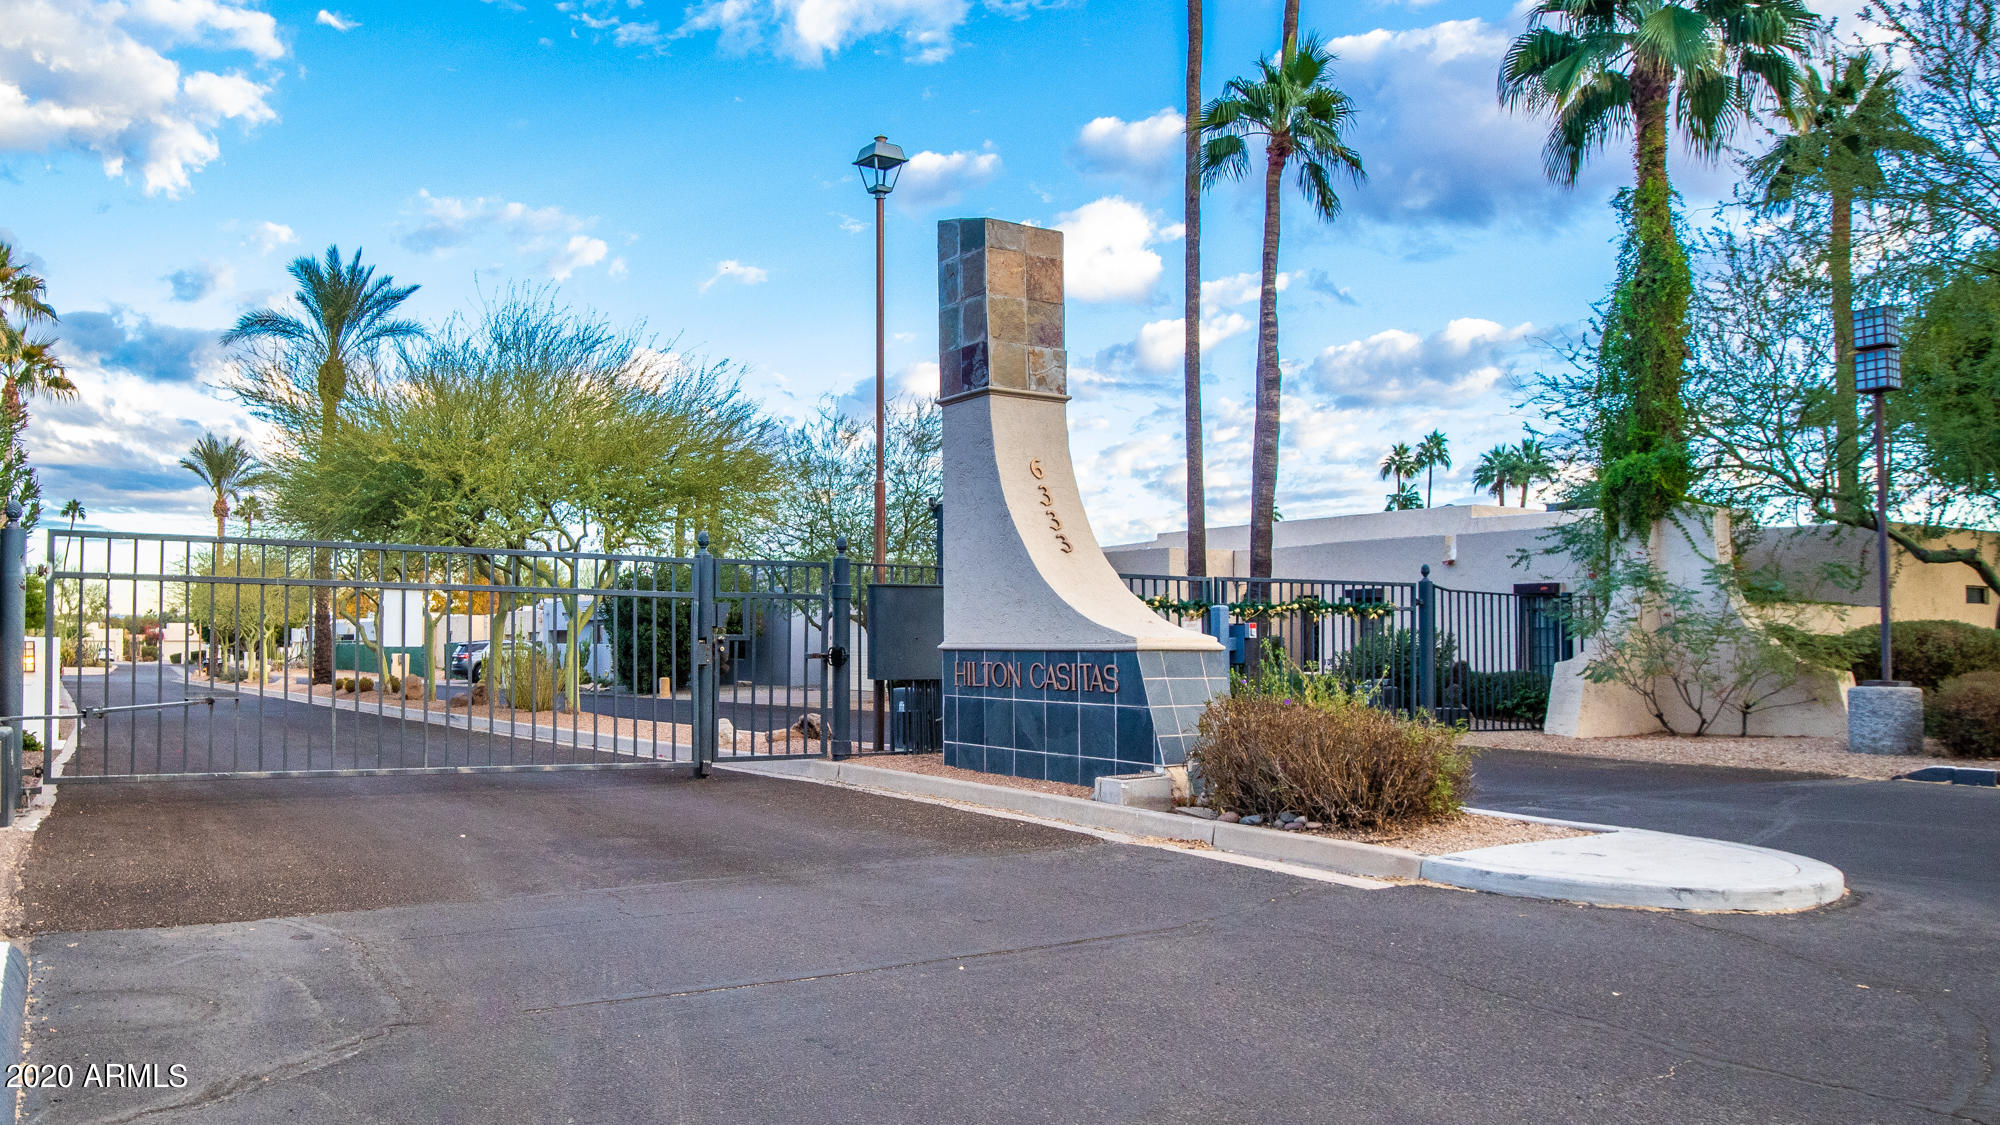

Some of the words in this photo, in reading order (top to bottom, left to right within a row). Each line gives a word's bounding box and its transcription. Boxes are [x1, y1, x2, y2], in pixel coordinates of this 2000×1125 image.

[1029, 456, 1073, 553] 6333
[954, 660, 1022, 688] HILTON
[1029, 662, 1120, 693] CASITAS
